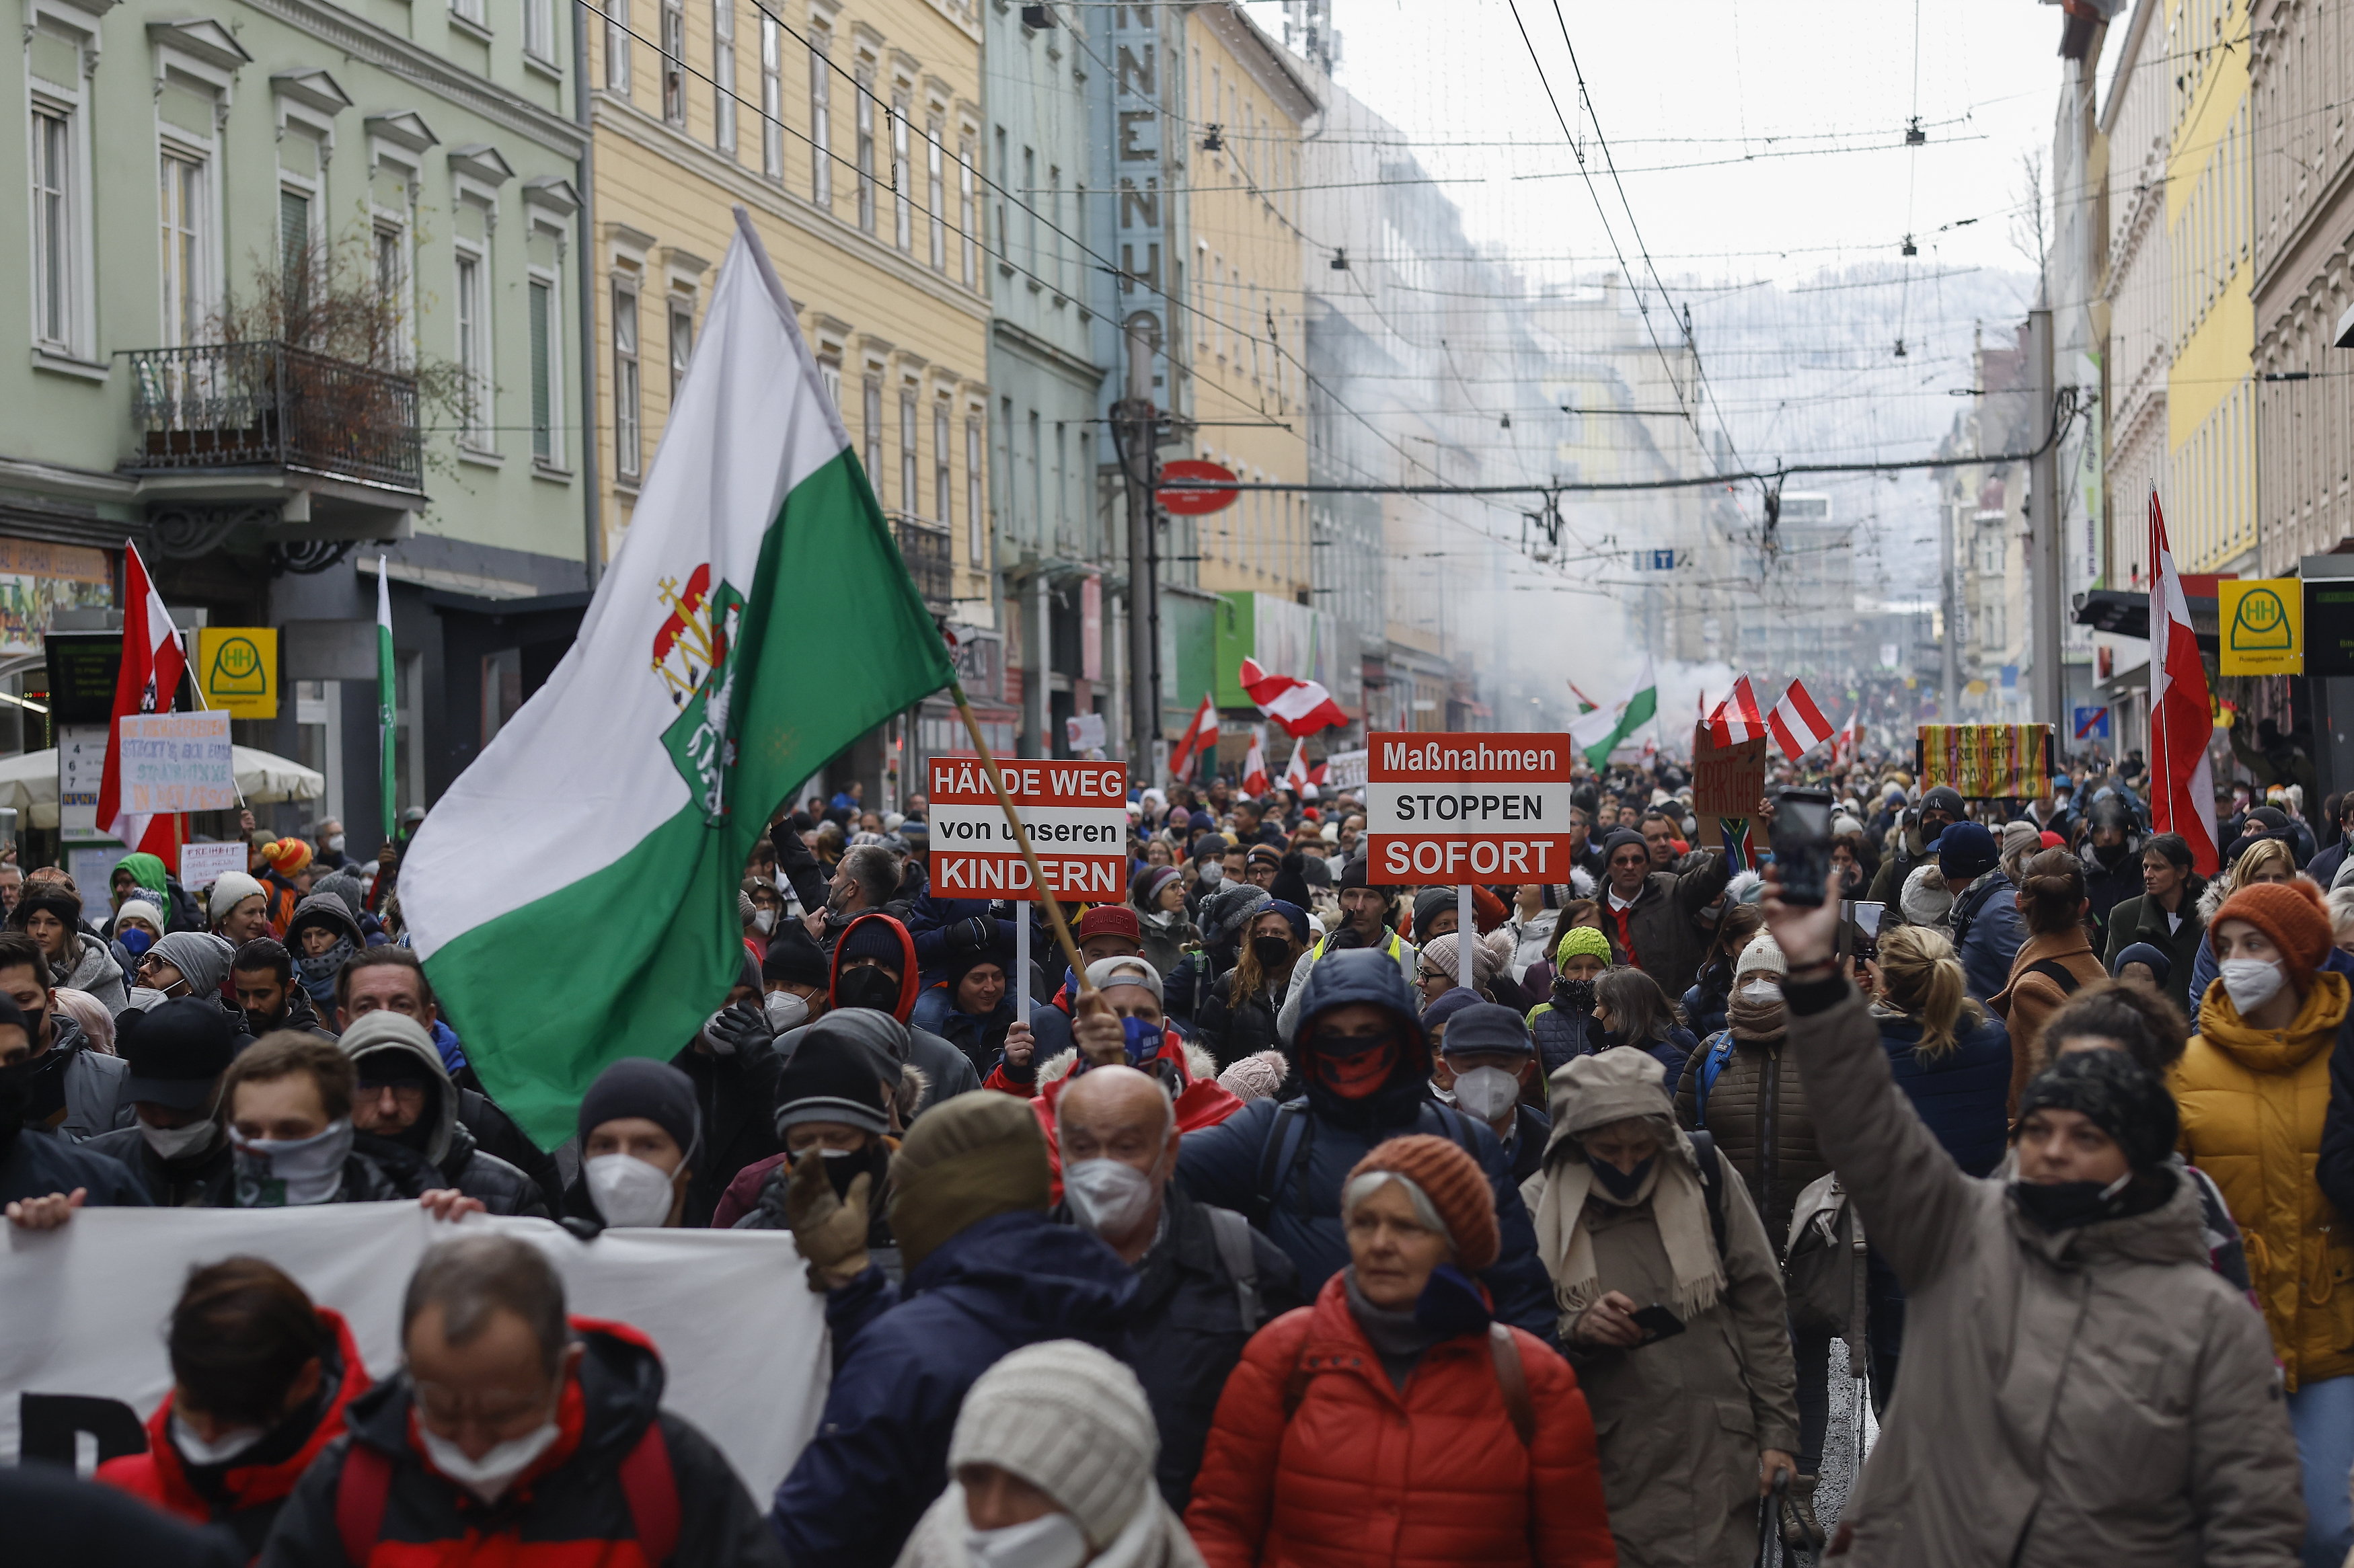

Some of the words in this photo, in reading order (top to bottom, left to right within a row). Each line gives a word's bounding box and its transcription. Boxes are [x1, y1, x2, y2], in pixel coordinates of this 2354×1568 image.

[1383, 742, 1556, 771] Maßnahmen
[936, 762, 1041, 795] HÄNDE
[1050, 770, 1122, 797] WEG
[1396, 795, 1542, 820] STOPPEN
[940, 822, 991, 840] von
[1003, 823, 1116, 842] unseren
[187, 847, 239, 857] FREIHEIT
[1385, 841, 1554, 875] SOFORT
[942, 858, 1116, 892] KINDERN
[1090, 914, 1129, 928] CAVALIERS
